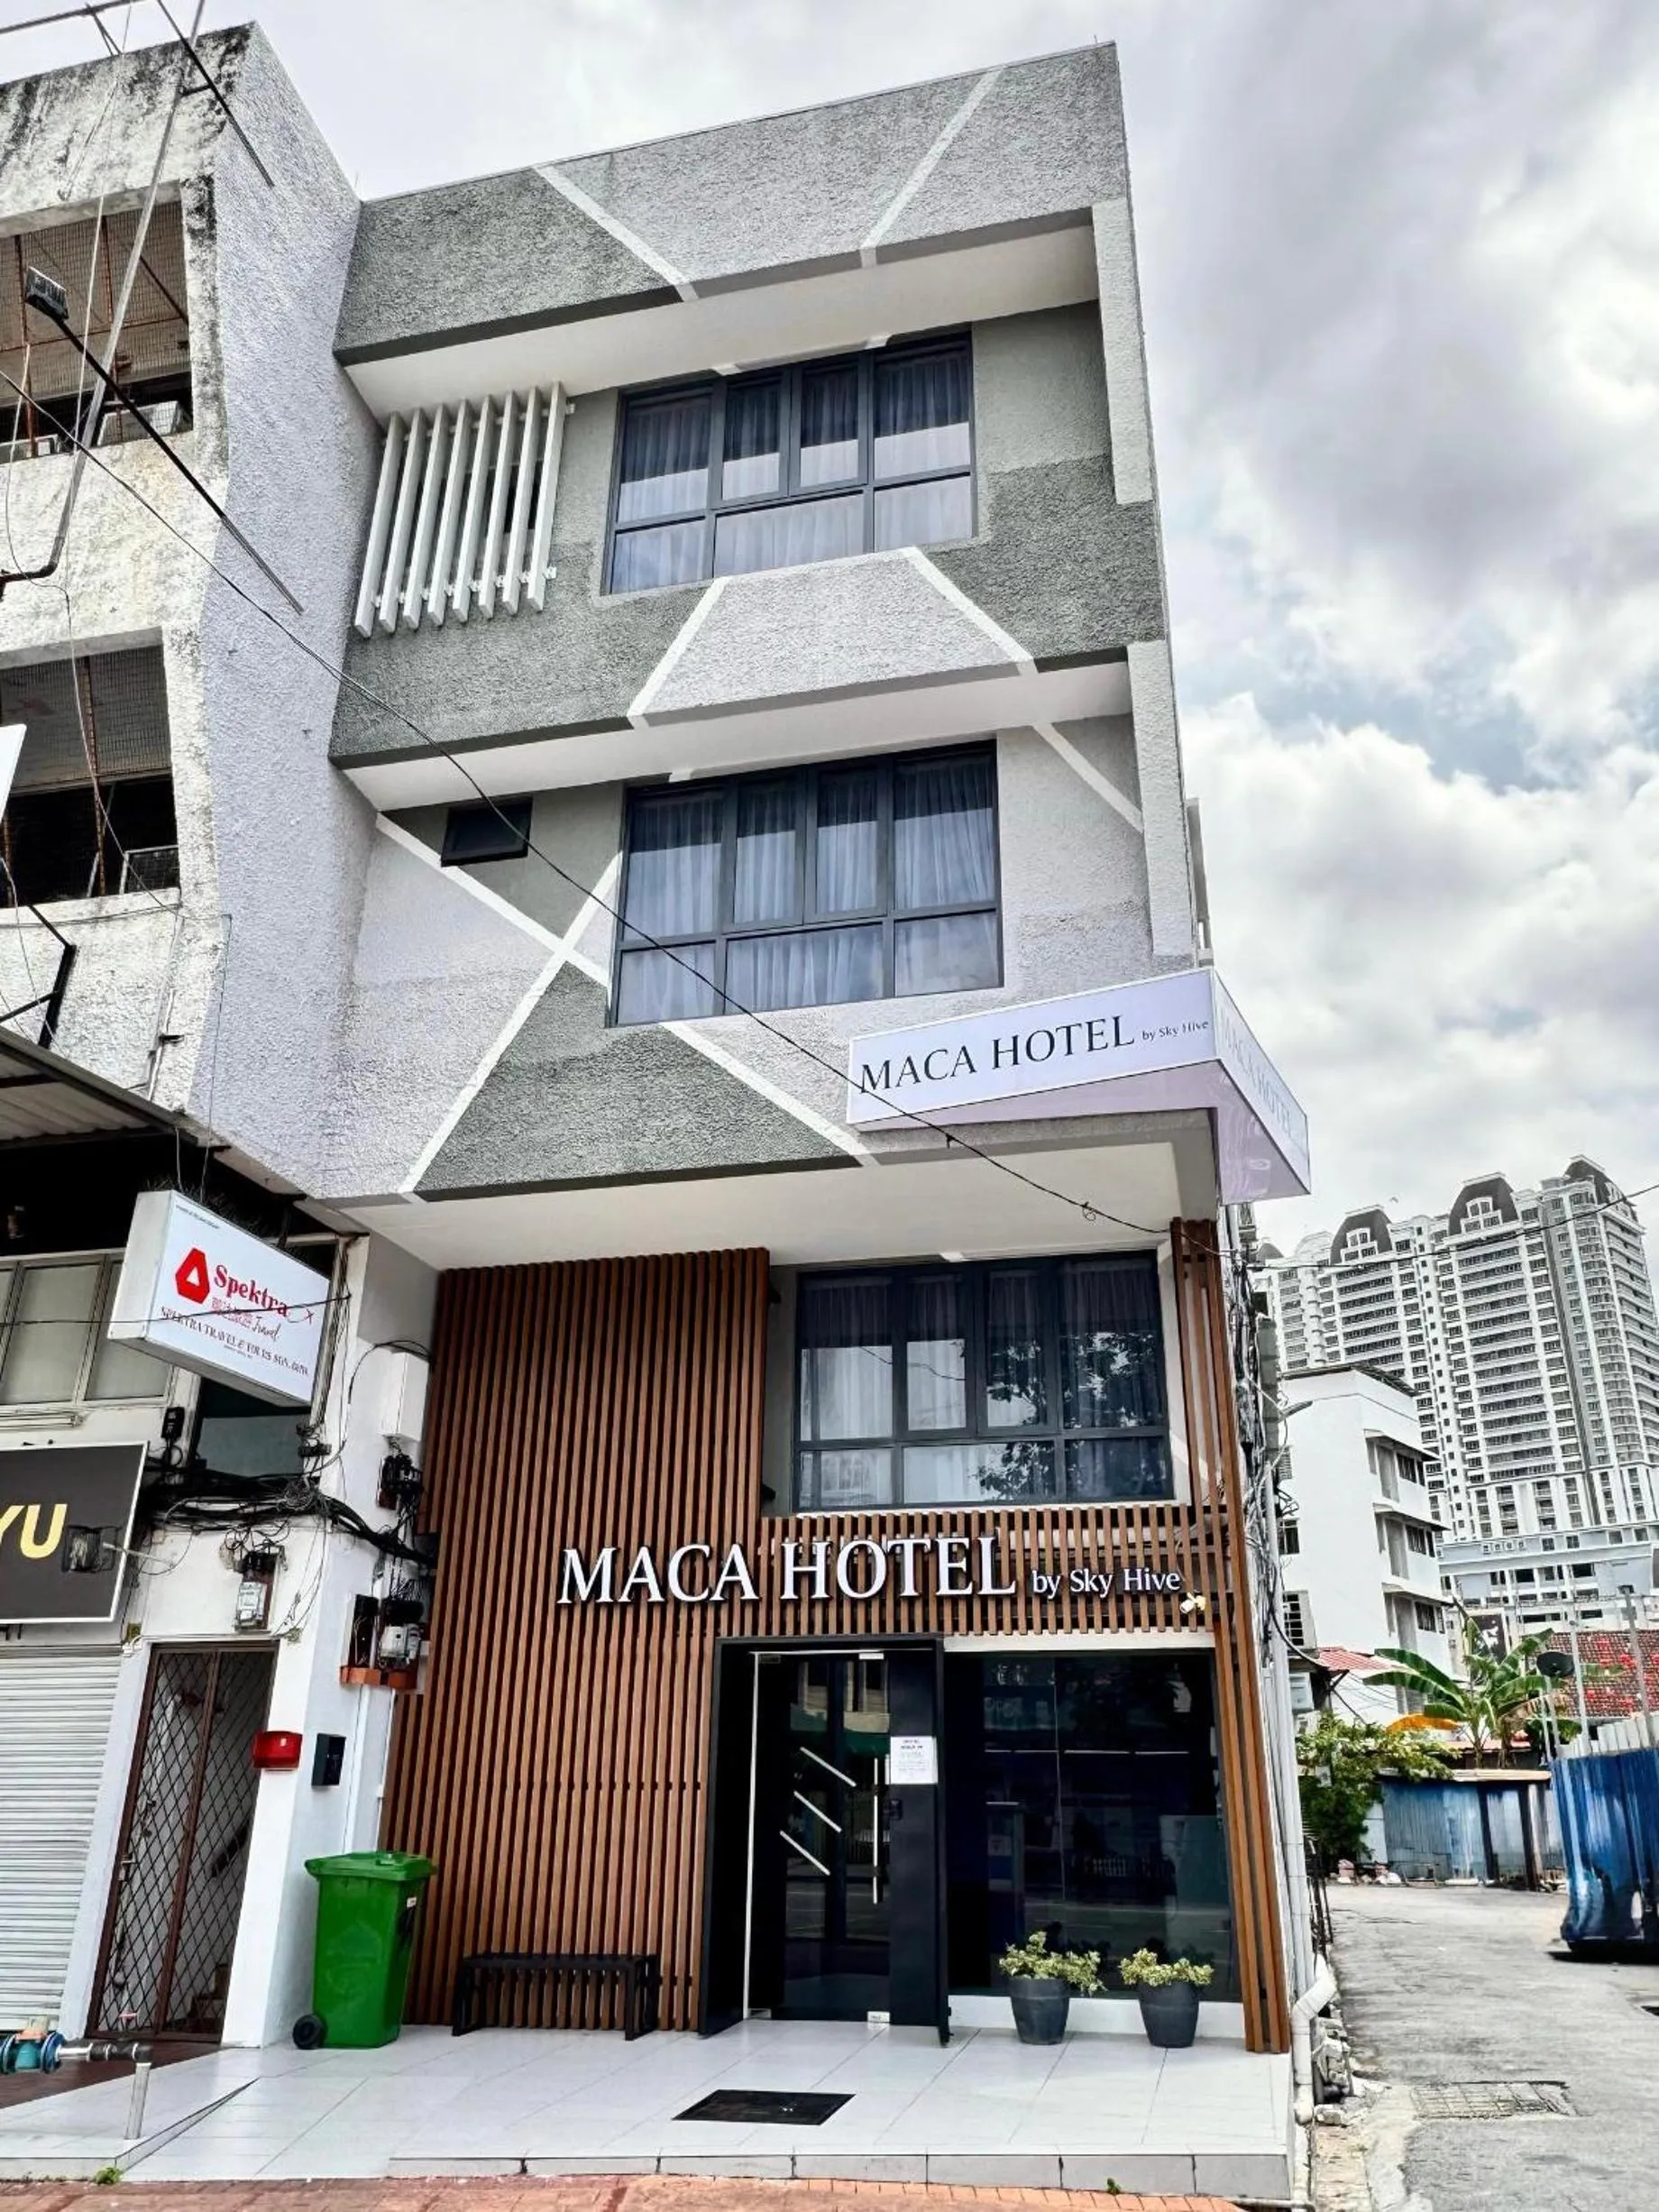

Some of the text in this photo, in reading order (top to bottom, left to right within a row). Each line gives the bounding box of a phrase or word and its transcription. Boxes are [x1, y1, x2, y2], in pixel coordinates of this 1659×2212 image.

[859, 1044, 976, 1094] MACA
[991, 1014, 1135, 1069] HOTEL
[1142, 1029, 1155, 1042] by
[1159, 1025, 1178, 1039] Sky
[214, 1264, 290, 1317] Spektra
[556, 1536, 1182, 1605] MACA HOTEL by Sky Hive
